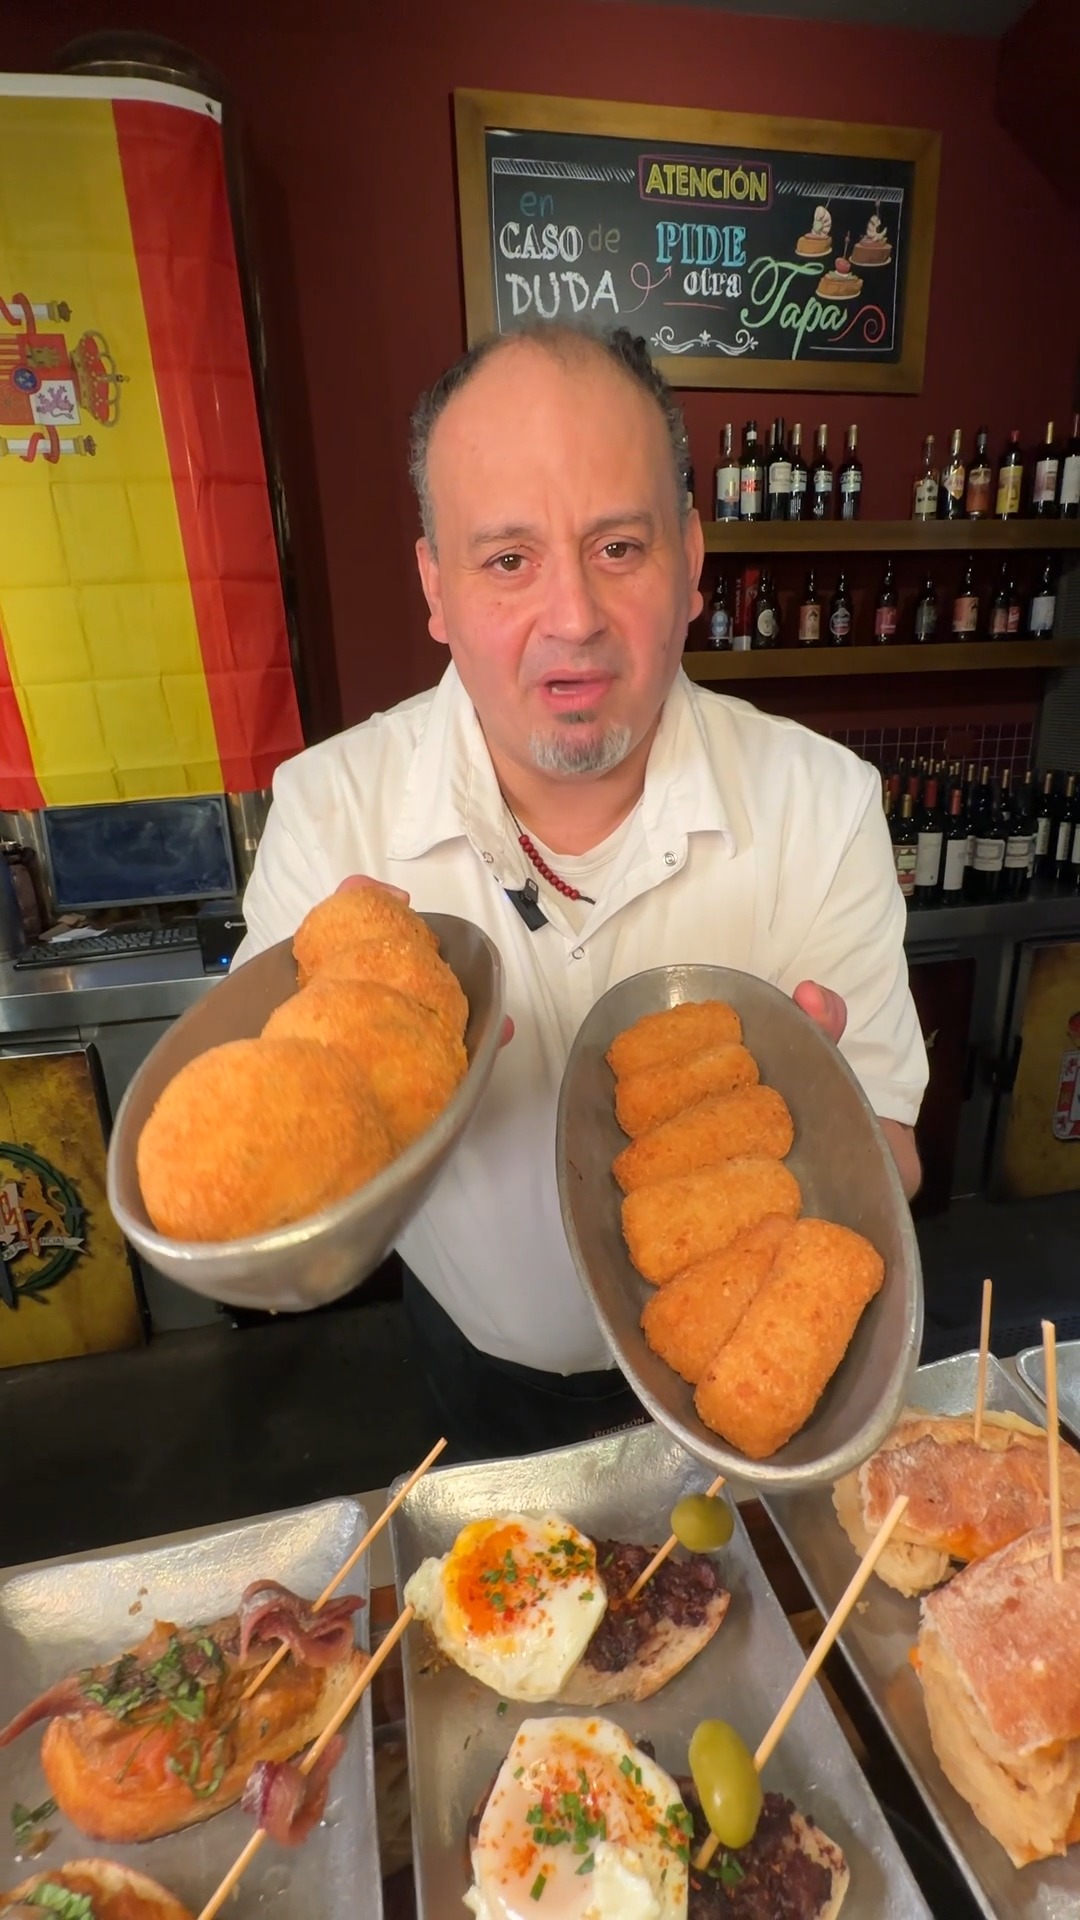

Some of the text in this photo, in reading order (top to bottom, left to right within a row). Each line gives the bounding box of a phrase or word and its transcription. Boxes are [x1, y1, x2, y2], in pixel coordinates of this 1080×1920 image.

[645, 163, 767, 201] ATENCIÓN
[519, 191, 554, 218] en
[500, 221, 621, 262] CASO de
[655, 221, 747, 267] PIDE
[505, 269, 620, 319] DUDA
[683, 267, 743, 298] otra
[740, 255, 848, 361] Tapa
